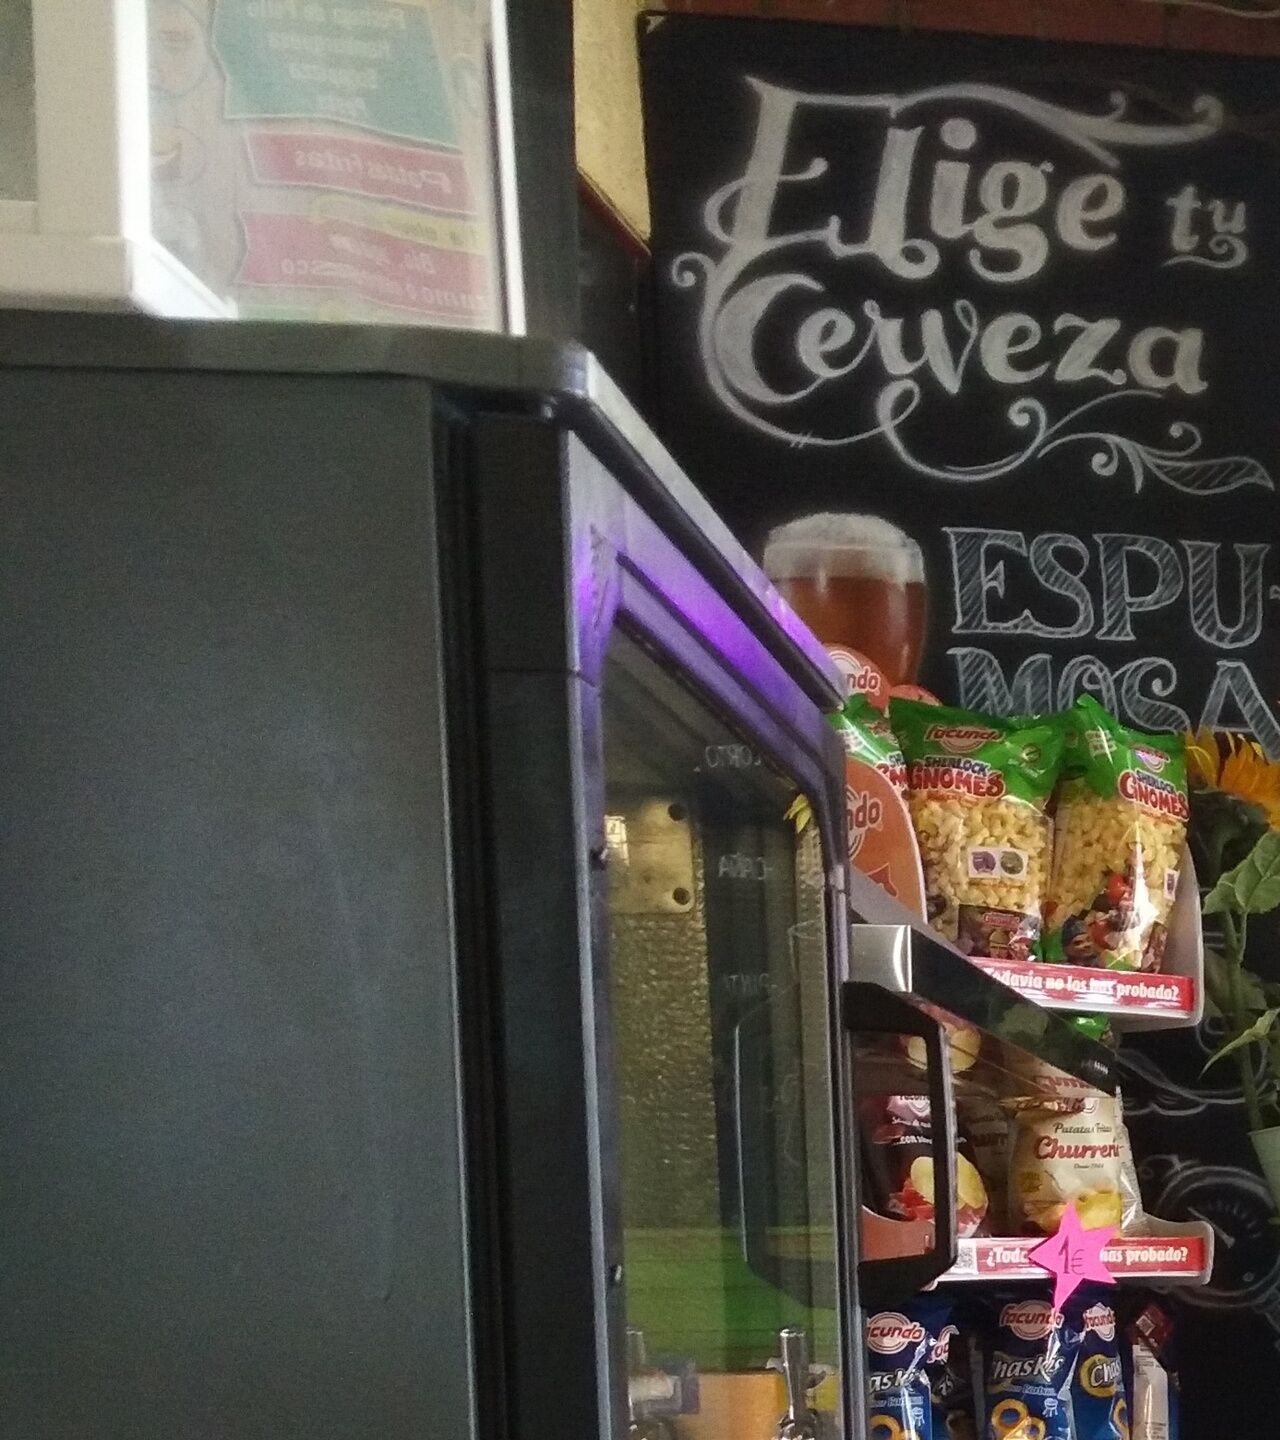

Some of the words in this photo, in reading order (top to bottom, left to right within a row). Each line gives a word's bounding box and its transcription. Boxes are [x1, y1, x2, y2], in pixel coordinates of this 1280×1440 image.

[702, 74, 1140, 283] Elige
[1164, 186, 1248, 264] tu
[698, 270, 1208, 420] Cerveza
[908, 764, 1006, 800] GNOMES
[924, 756, 988, 773] SHERLOCK
[1118, 770, 1190, 820] GNOMES
[1116, 983, 1179, 1001] probado?
[1053, 1122, 1095, 1134] Patatas
[1058, 1235, 1086, 1276] 1€
[1126, 1247, 1188, 1265] probado?
